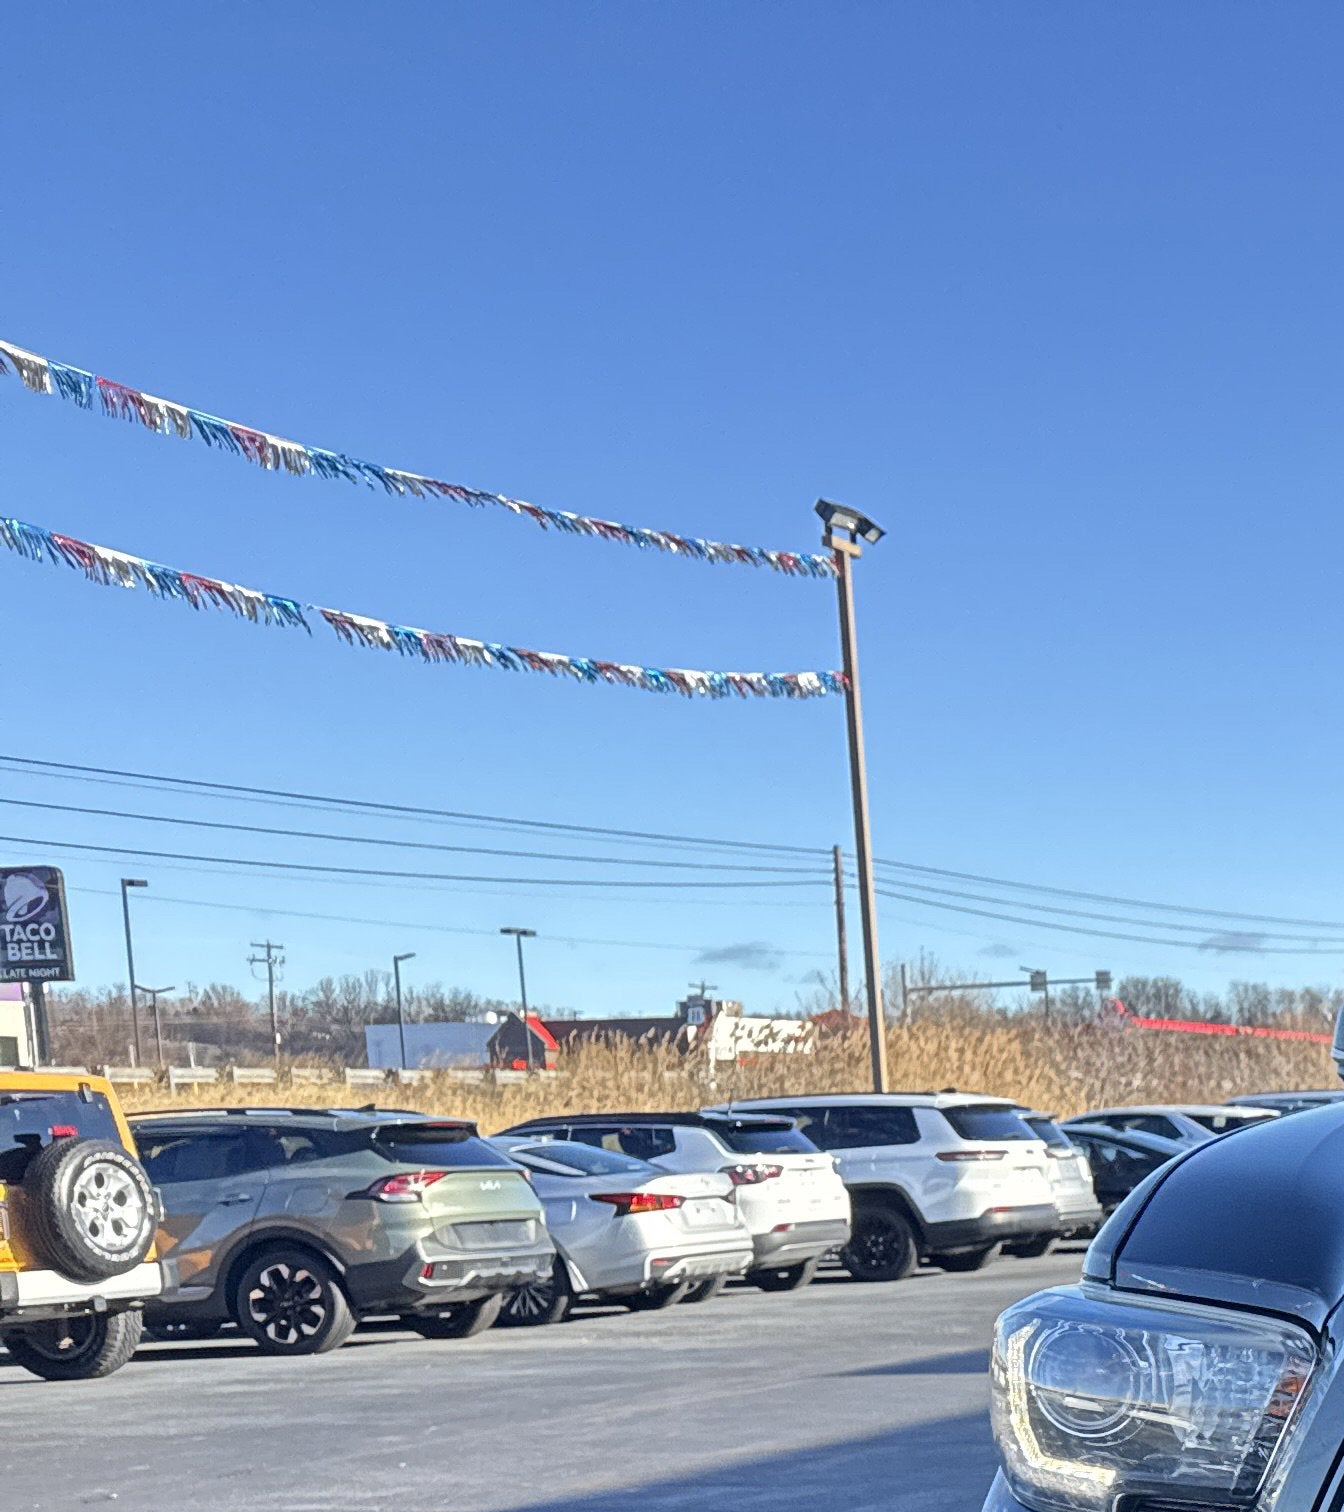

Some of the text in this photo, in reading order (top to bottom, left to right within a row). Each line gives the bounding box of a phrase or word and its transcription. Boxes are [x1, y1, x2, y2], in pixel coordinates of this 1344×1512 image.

[0, 922, 56, 942] TACO
[7, 941, 58, 961] BELL
[3, 966, 60, 979] LATE NIGHT
